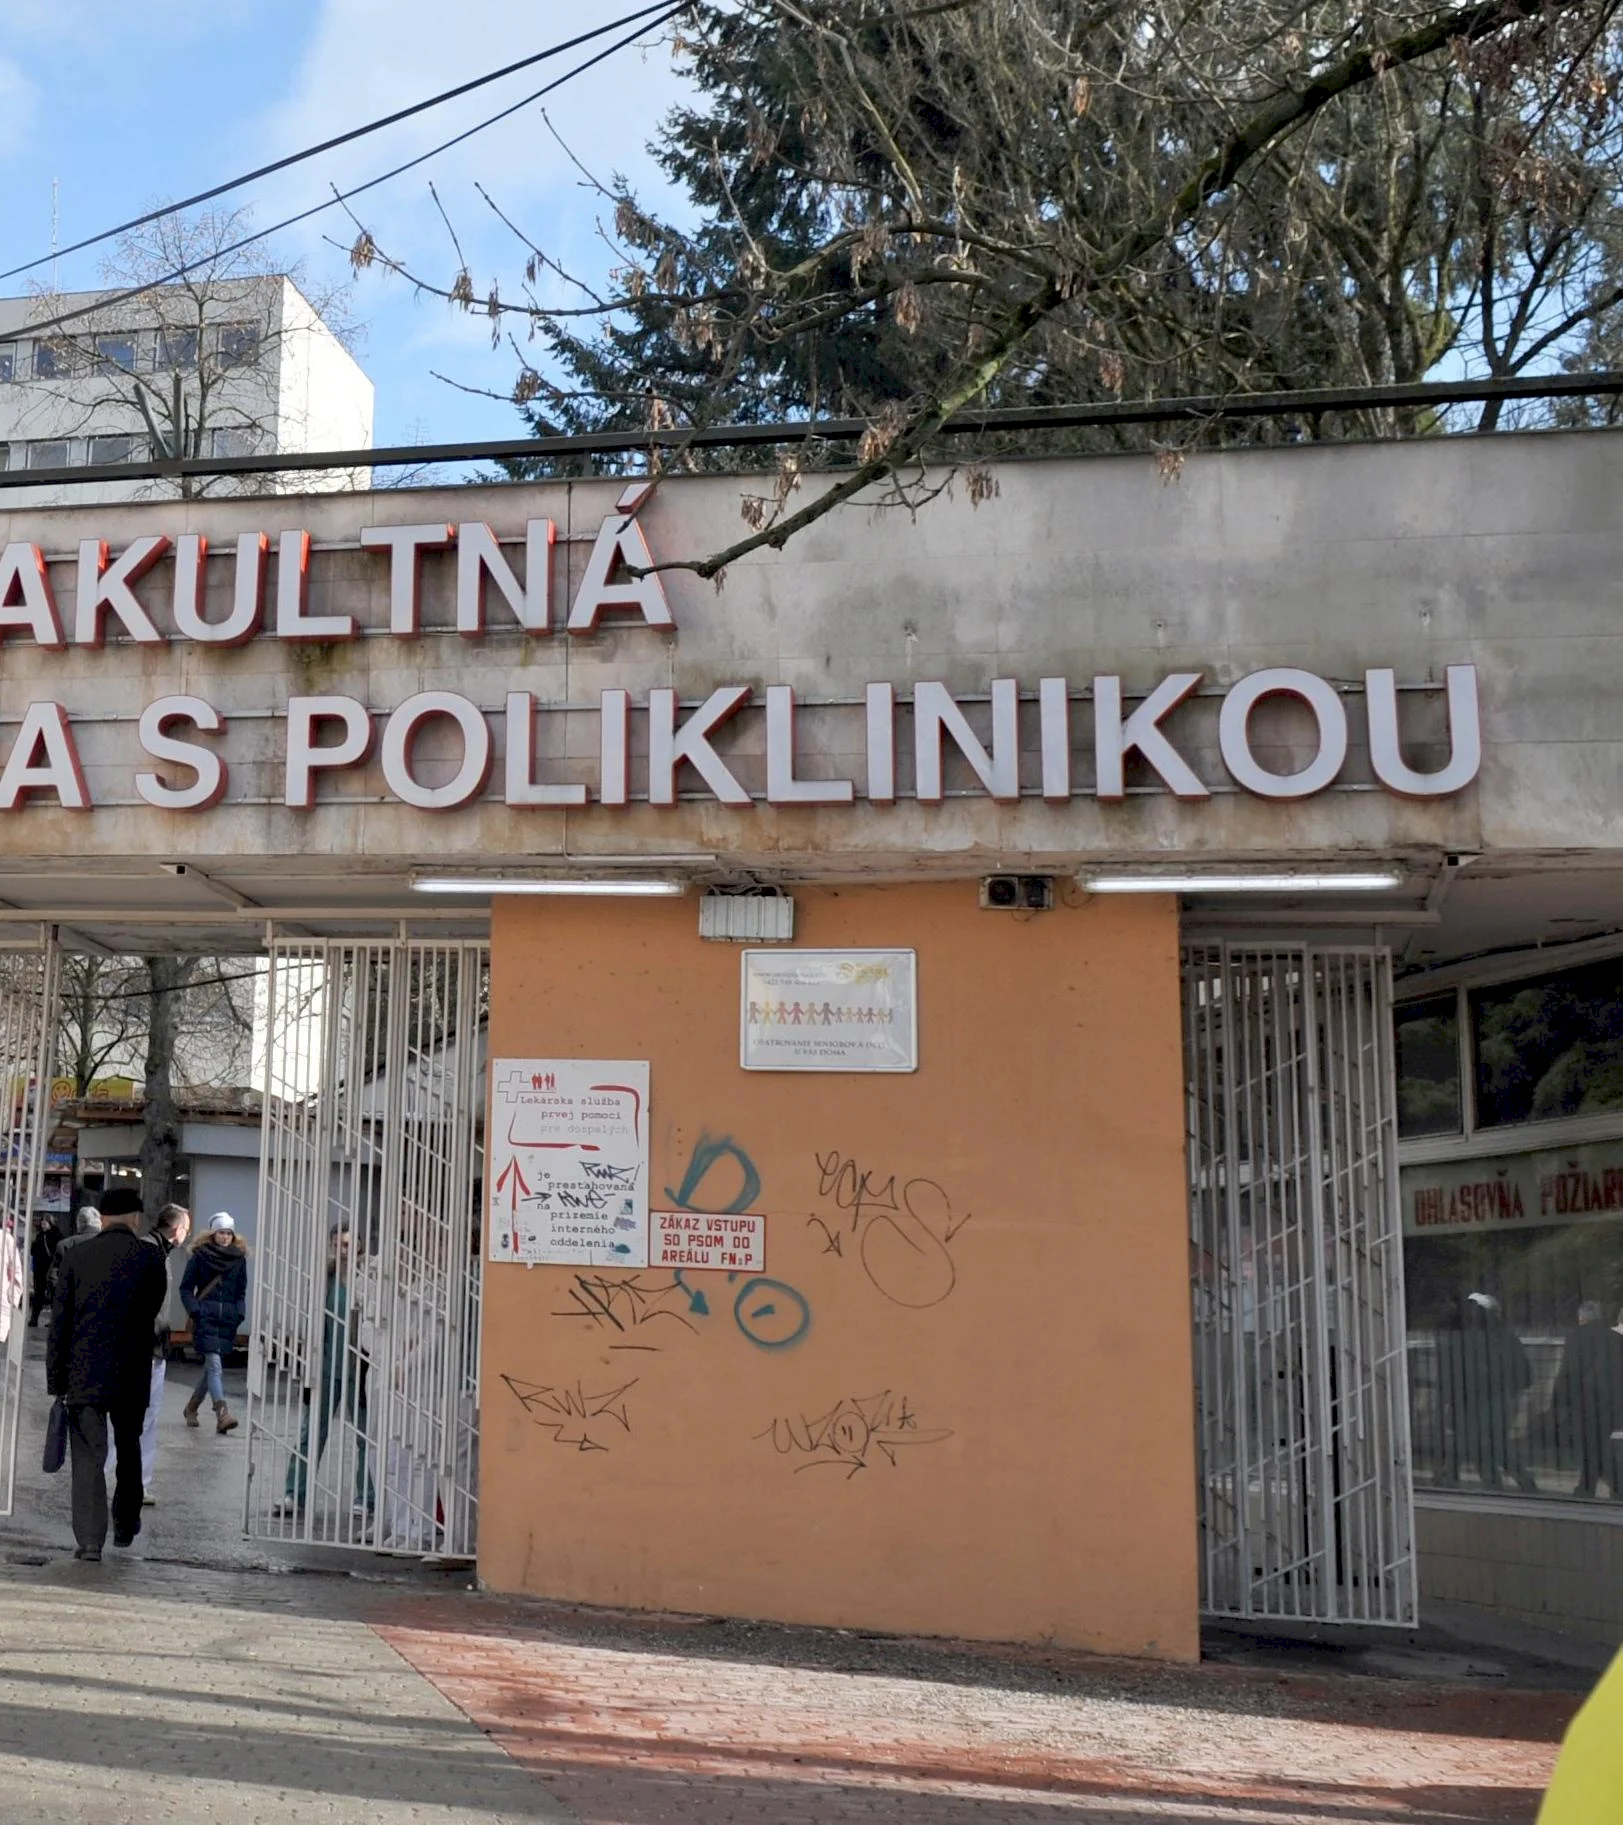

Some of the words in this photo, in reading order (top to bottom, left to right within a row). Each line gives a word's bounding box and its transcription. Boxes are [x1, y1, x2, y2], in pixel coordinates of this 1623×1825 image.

[134, 694, 228, 811] S
[285, 663, 1482, 809] POLIKLINIKOU
[541, 1110, 574, 1120] prvej
[581, 1110, 622, 1121] pomoci
[540, 1125, 561, 1135] pre
[537, 1171, 551, 1182] je
[1541, 1161, 1623, 1216] POŽIAR
[536, 1202, 551, 1211] na
[660, 1215, 701, 1231] ZÁKAZ
[706, 1219, 756, 1233] VSTUPU
[551, 1226, 616, 1235] interného
[550, 1239, 615, 1249] oddelenia
[664, 1234, 681, 1247] SO
[687, 1235, 724, 1248] PSOM
[732, 1236, 750, 1249] DO
[661, 1248, 709, 1264] AREÁLU
